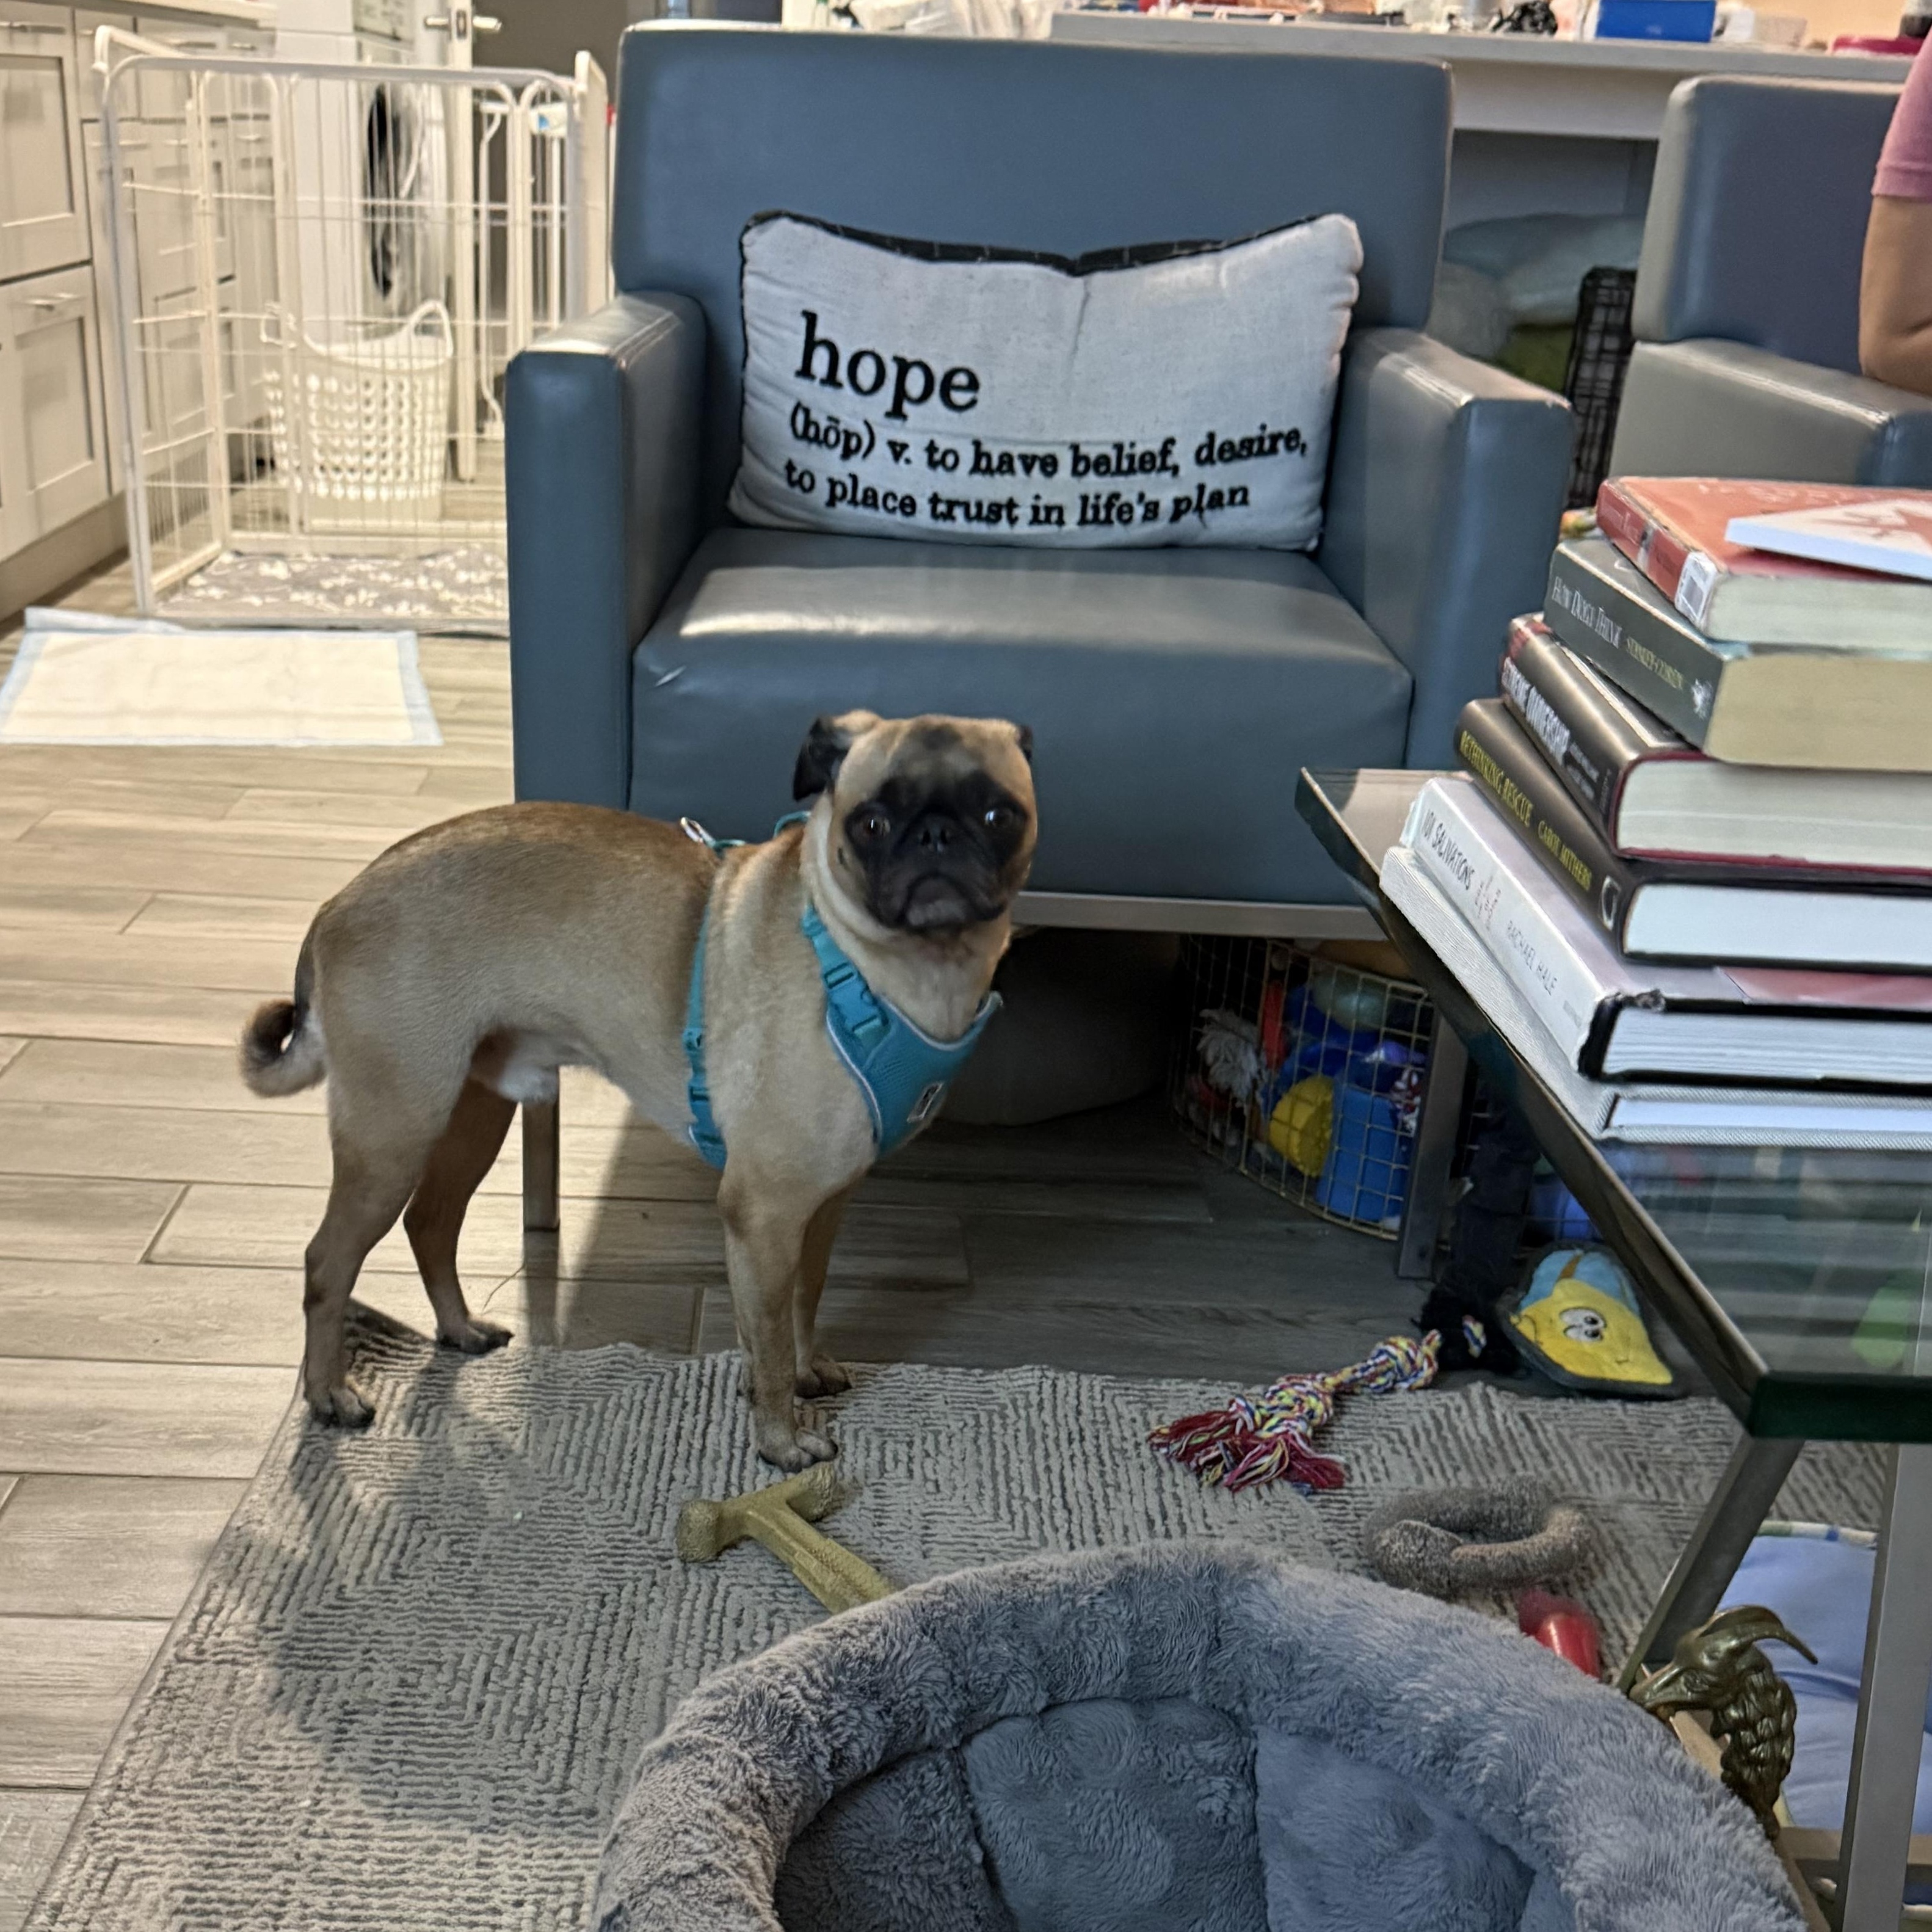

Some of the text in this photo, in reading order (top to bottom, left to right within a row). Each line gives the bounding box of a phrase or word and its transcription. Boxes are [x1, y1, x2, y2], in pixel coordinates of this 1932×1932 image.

[795, 310, 981, 421] hope
[791, 402, 1308, 478] (hōp) v. to have belief, desire,
[785, 459, 1250, 526] to place trust in life's plan
